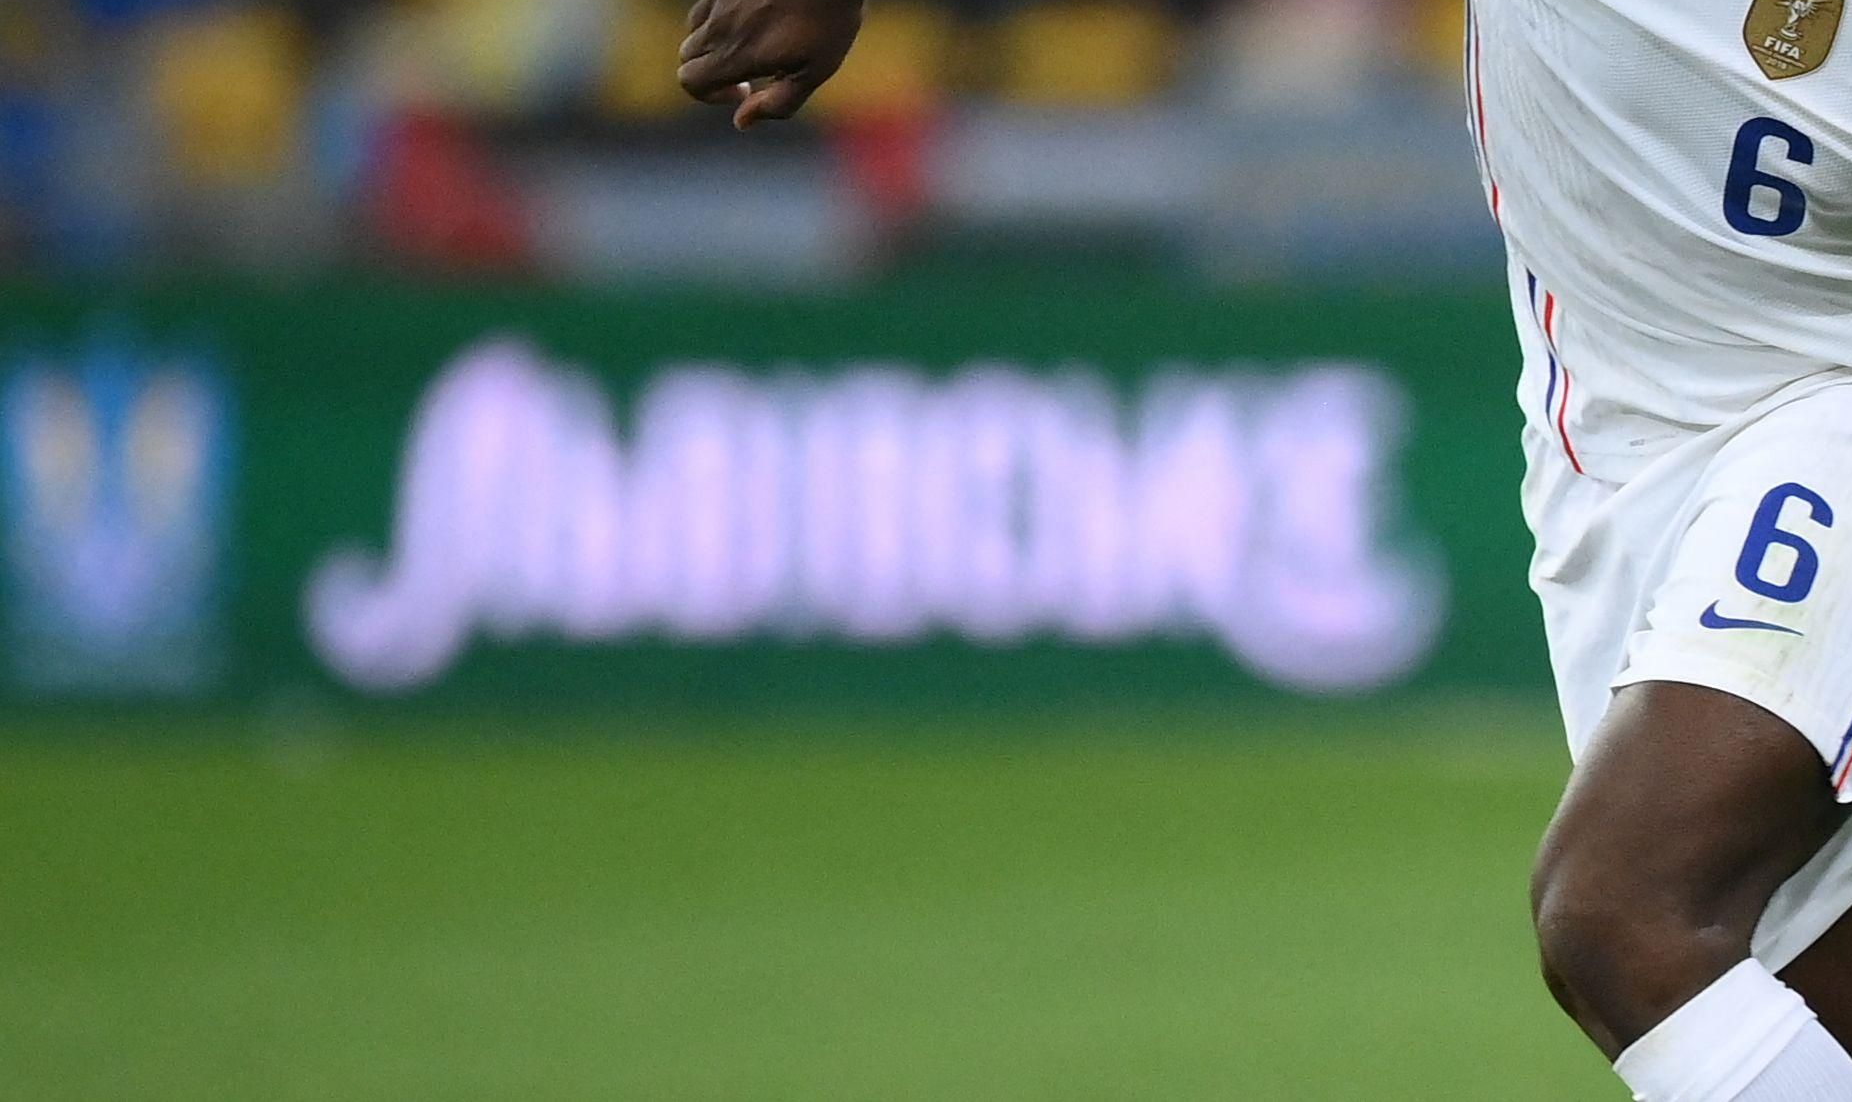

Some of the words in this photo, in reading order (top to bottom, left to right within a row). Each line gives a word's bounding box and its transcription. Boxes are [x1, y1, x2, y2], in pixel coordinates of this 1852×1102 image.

[1764, 36, 1800, 59] FIFA
[1723, 116, 1814, 237] 6
[1735, 482, 1833, 603] 6
